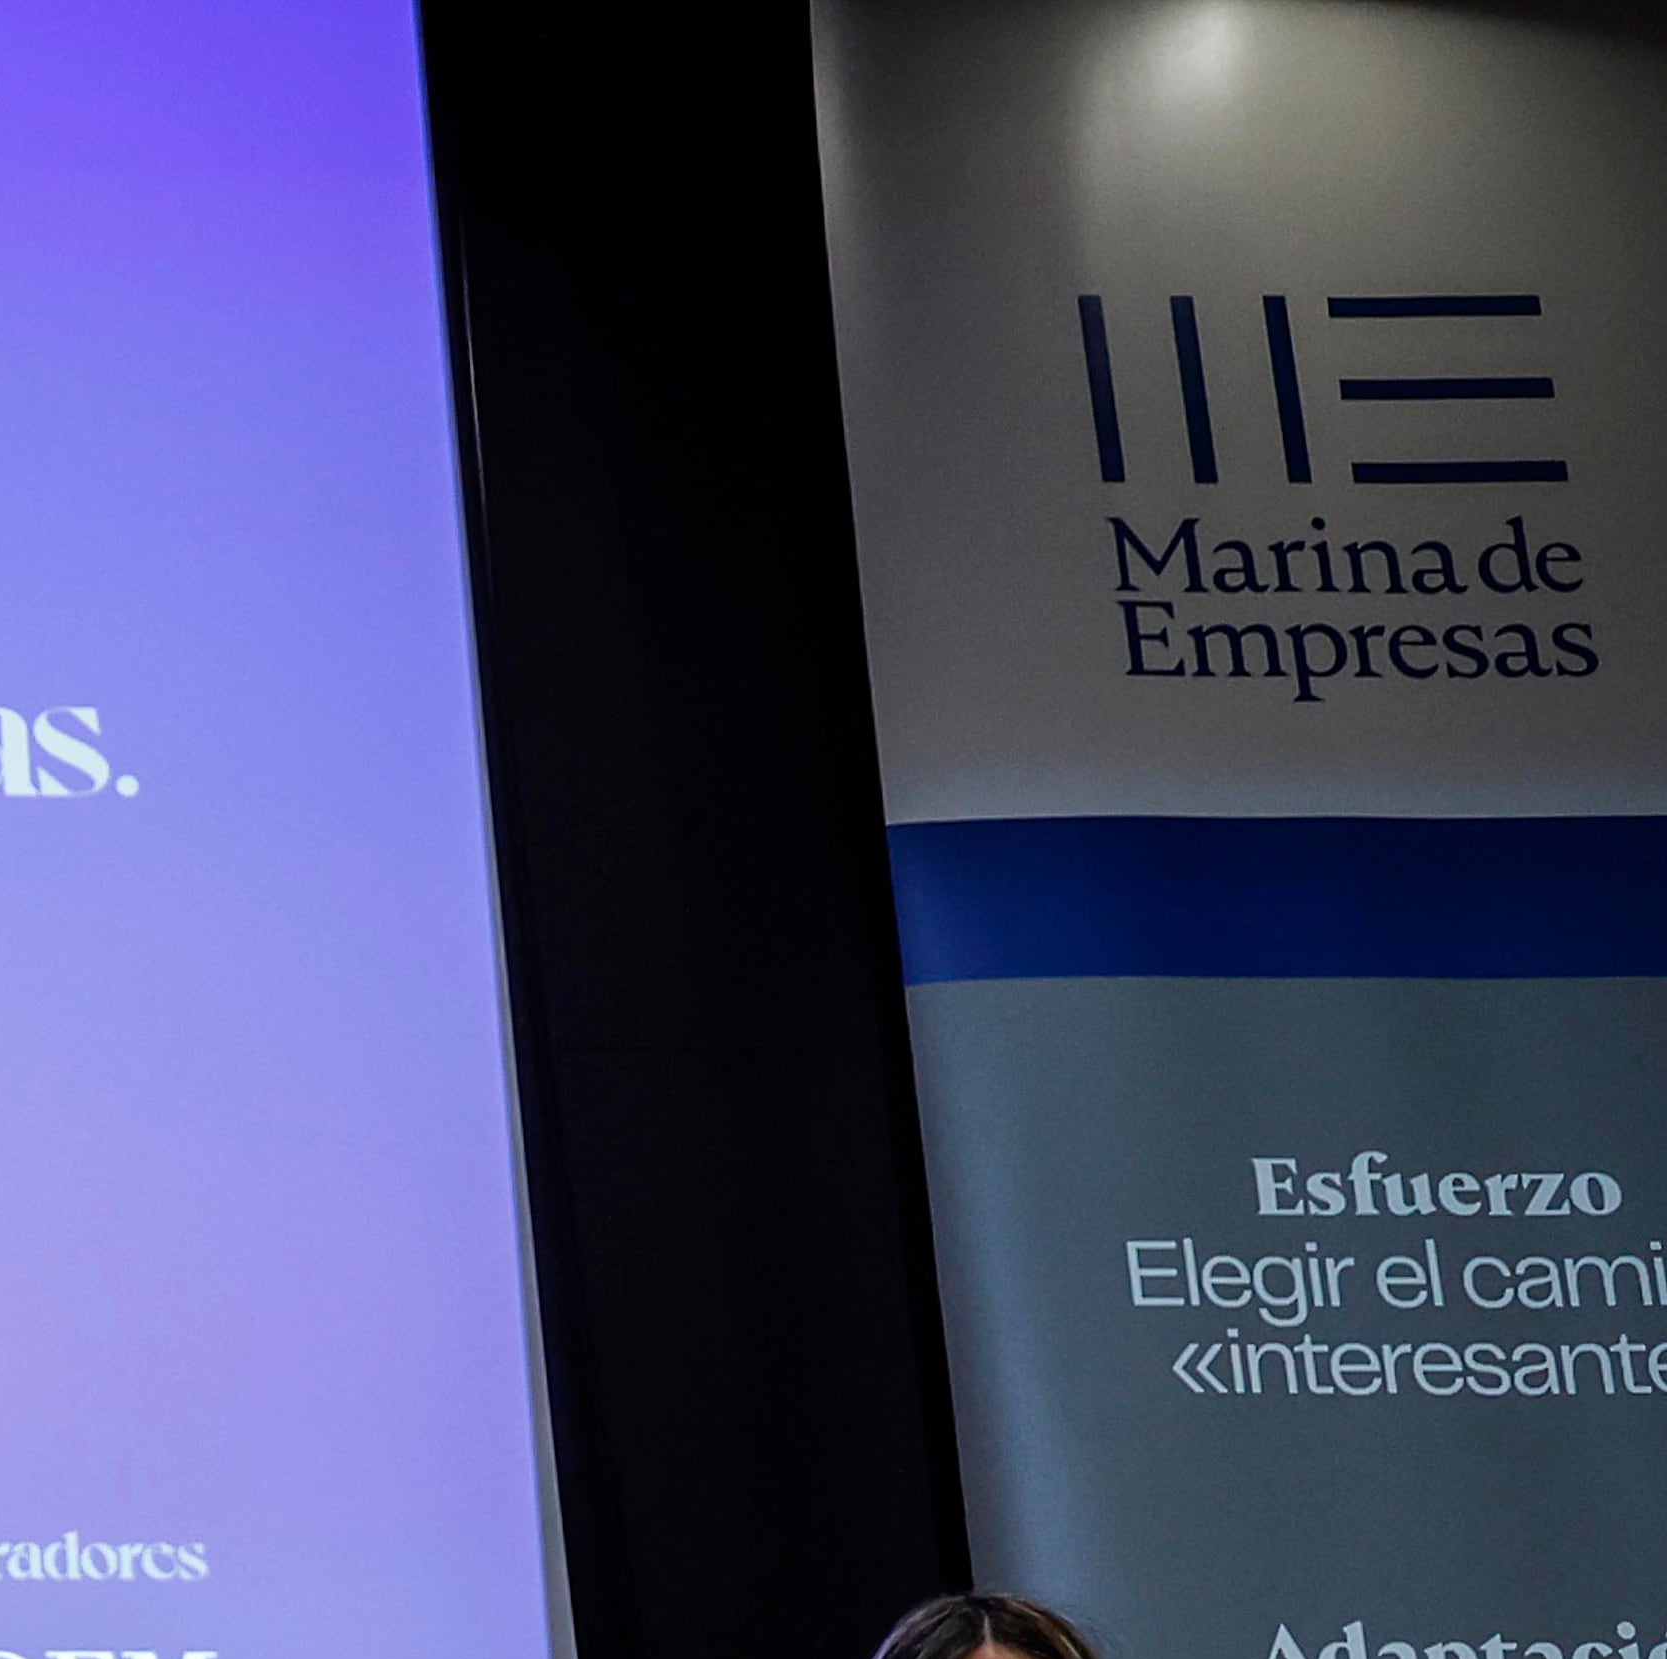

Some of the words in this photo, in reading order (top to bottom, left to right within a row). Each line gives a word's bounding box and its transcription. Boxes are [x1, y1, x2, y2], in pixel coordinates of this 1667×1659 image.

[1106, 516, 1469, 595] Marina
[1477, 515, 1584, 594] de
[1116, 600, 1600, 703] Empresas
[1251, 1151, 1622, 1216] Esfuerzo
[1126, 1237, 1355, 1327] Elegir
[1376, 1238, 1444, 1308] el
